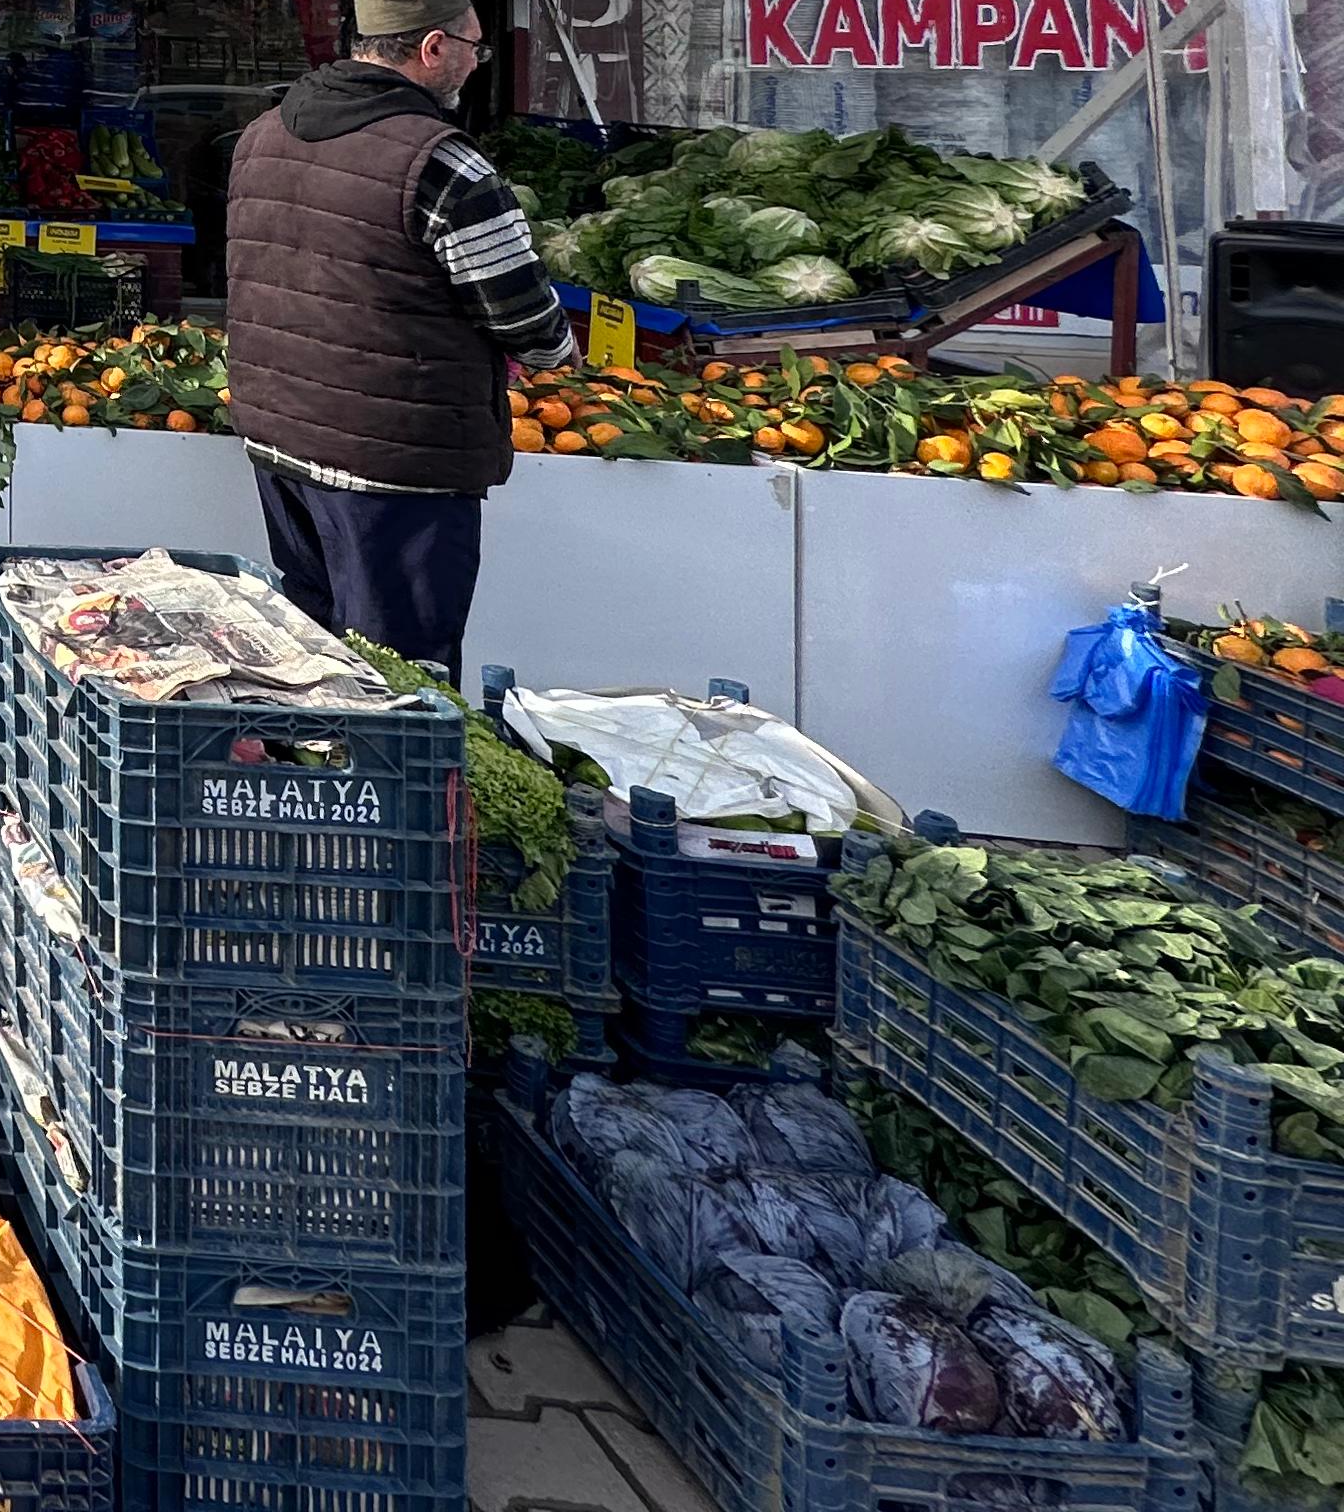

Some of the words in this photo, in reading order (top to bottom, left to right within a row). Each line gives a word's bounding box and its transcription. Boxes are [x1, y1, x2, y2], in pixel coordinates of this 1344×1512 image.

[203, 778, 380, 807] MALATYA
[201, 798, 272, 818] SEBZE
[331, 804, 381, 825] 2024
[500, 941, 545, 956] 2024
[214, 1059, 368, 1088] MALATYA
[214, 1079, 297, 1099] SEBZE
[204, 1340, 275, 1364] SEBZE
[332, 1351, 383, 1373] 2024
